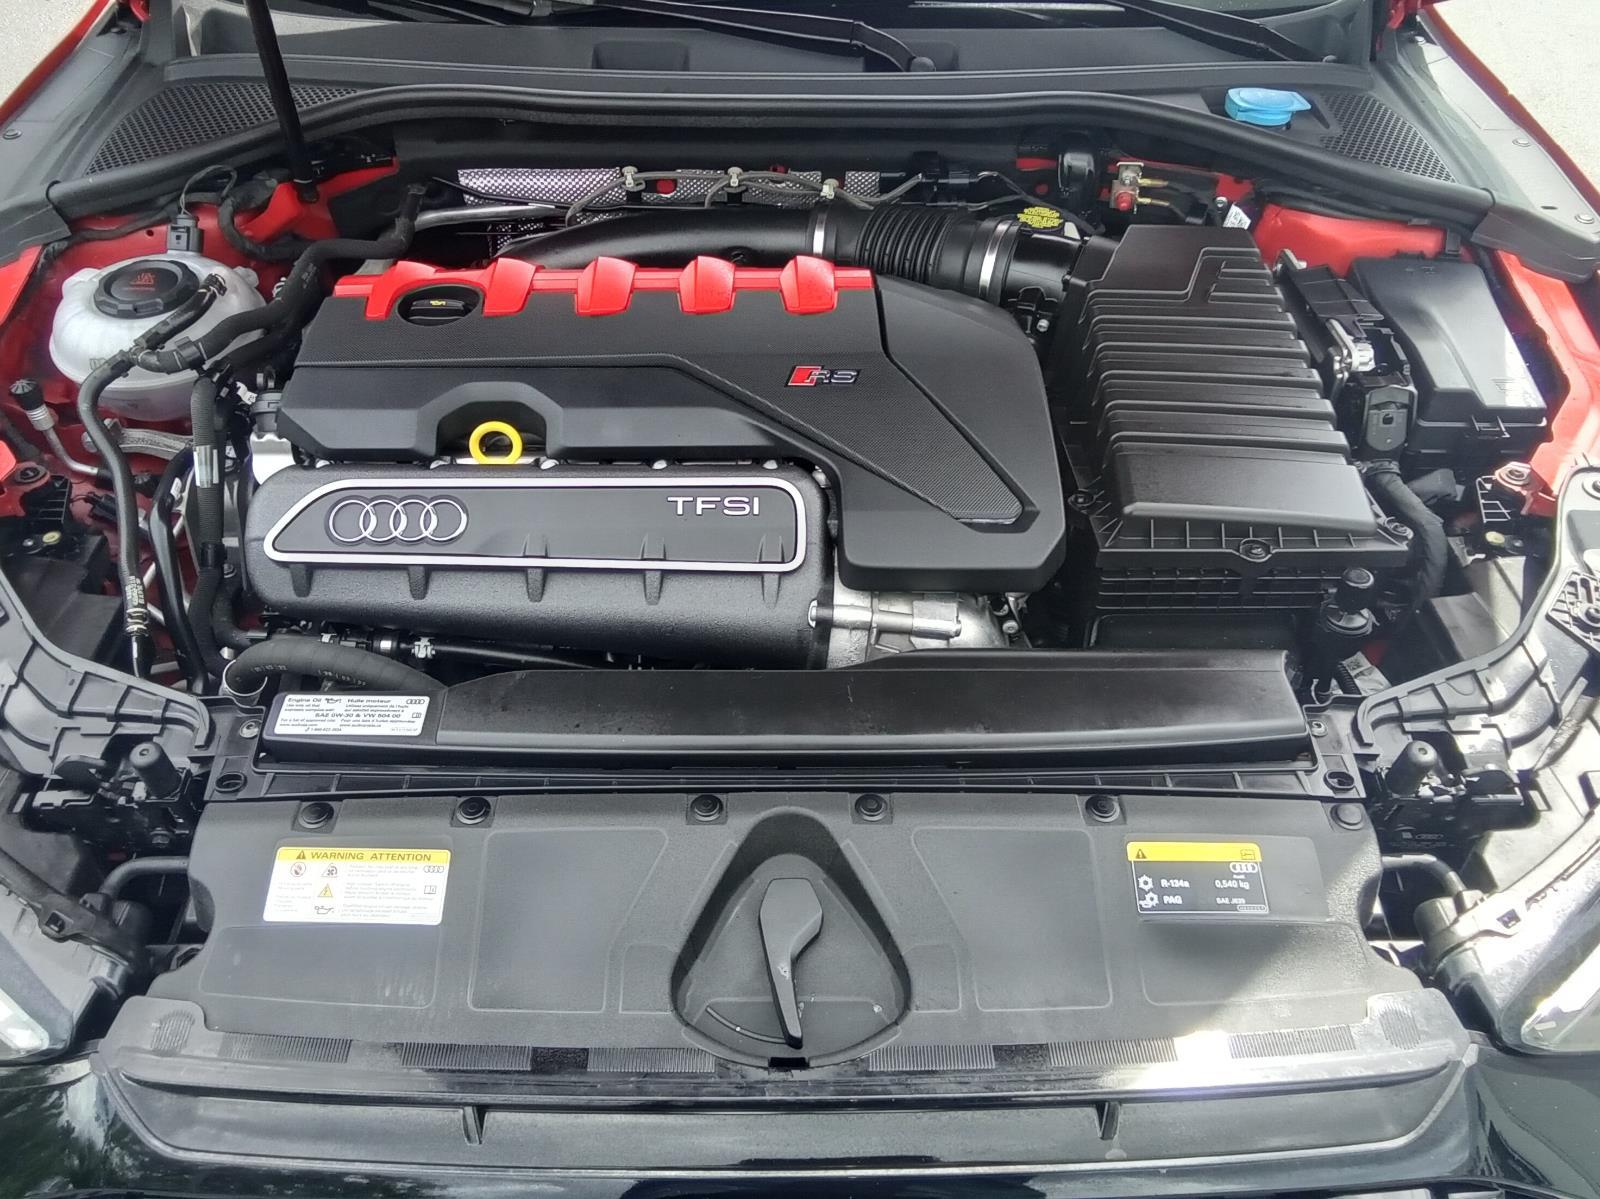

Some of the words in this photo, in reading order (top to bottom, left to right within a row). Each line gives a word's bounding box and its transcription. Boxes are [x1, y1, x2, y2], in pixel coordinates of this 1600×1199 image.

[799, 368, 859, 385] RS
[666, 495, 761, 517] TFSI
[310, 851, 366, 861] WARNING
[369, 852, 433, 862] ATTENTION
[1160, 879, 1190, 888] R-134a
[1214, 879, 1238, 888] 0,540
[1238, 879, 1250, 890] kg
[1162, 895, 1183, 904] PAG
